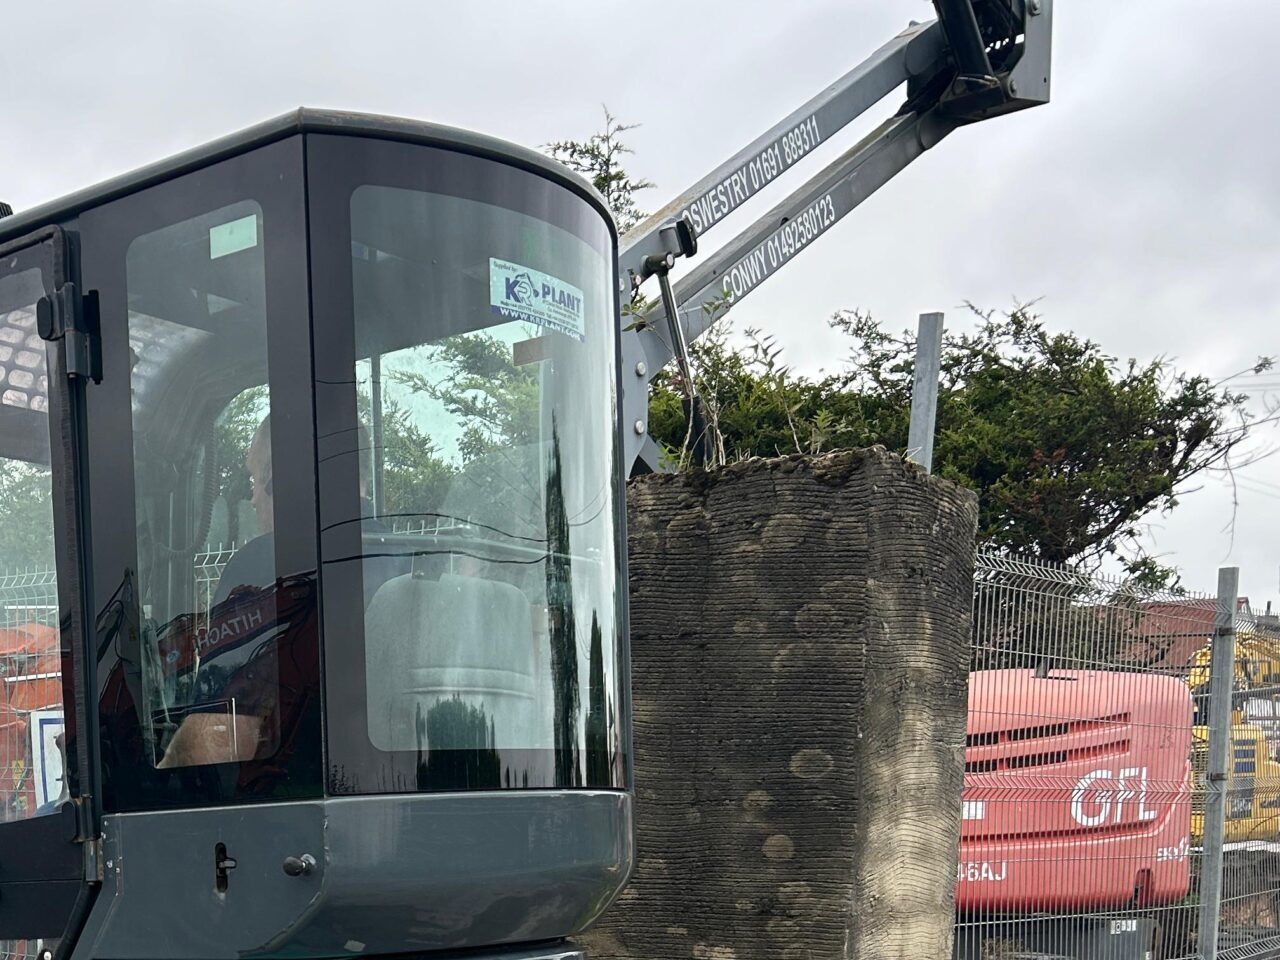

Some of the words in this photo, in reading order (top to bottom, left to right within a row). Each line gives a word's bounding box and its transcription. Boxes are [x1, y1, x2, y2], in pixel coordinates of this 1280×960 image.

[750, 143, 784, 190] 01691
[782, 115, 821, 165] 889311
[723, 249, 769, 304] CONWY
[768, 194, 836, 268] 01492580123
[542, 283, 581, 313] PLANT
